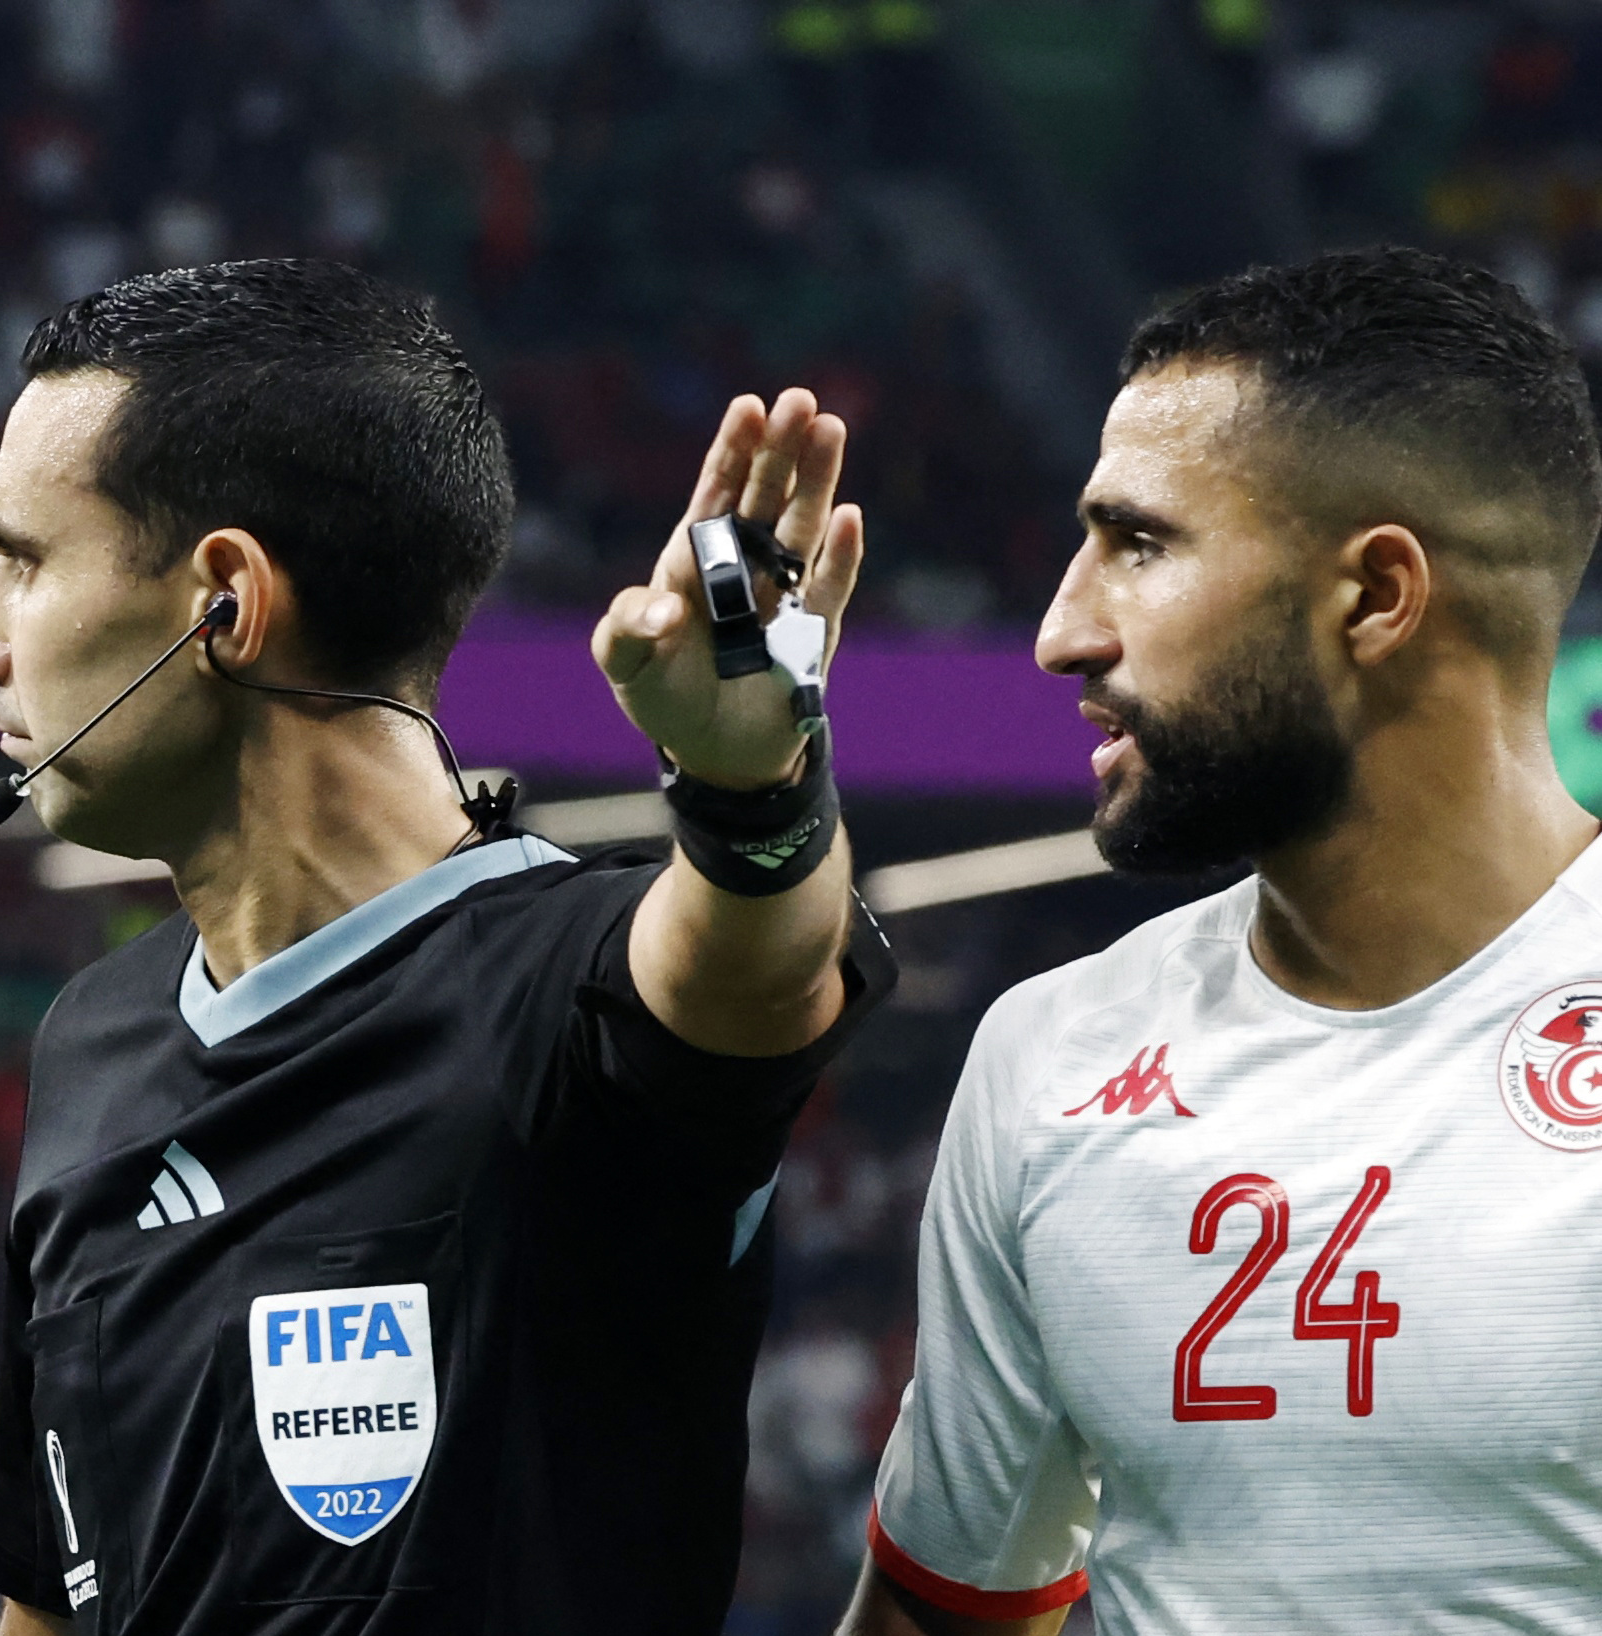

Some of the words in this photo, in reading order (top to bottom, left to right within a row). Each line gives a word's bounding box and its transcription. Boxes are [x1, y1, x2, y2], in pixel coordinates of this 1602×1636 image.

[1173, 1166, 1400, 1422] 24
[267, 1302, 412, 1367] FIFA
[272, 1402, 419, 1440] REFEREE
[316, 1488, 384, 1518] 2022
